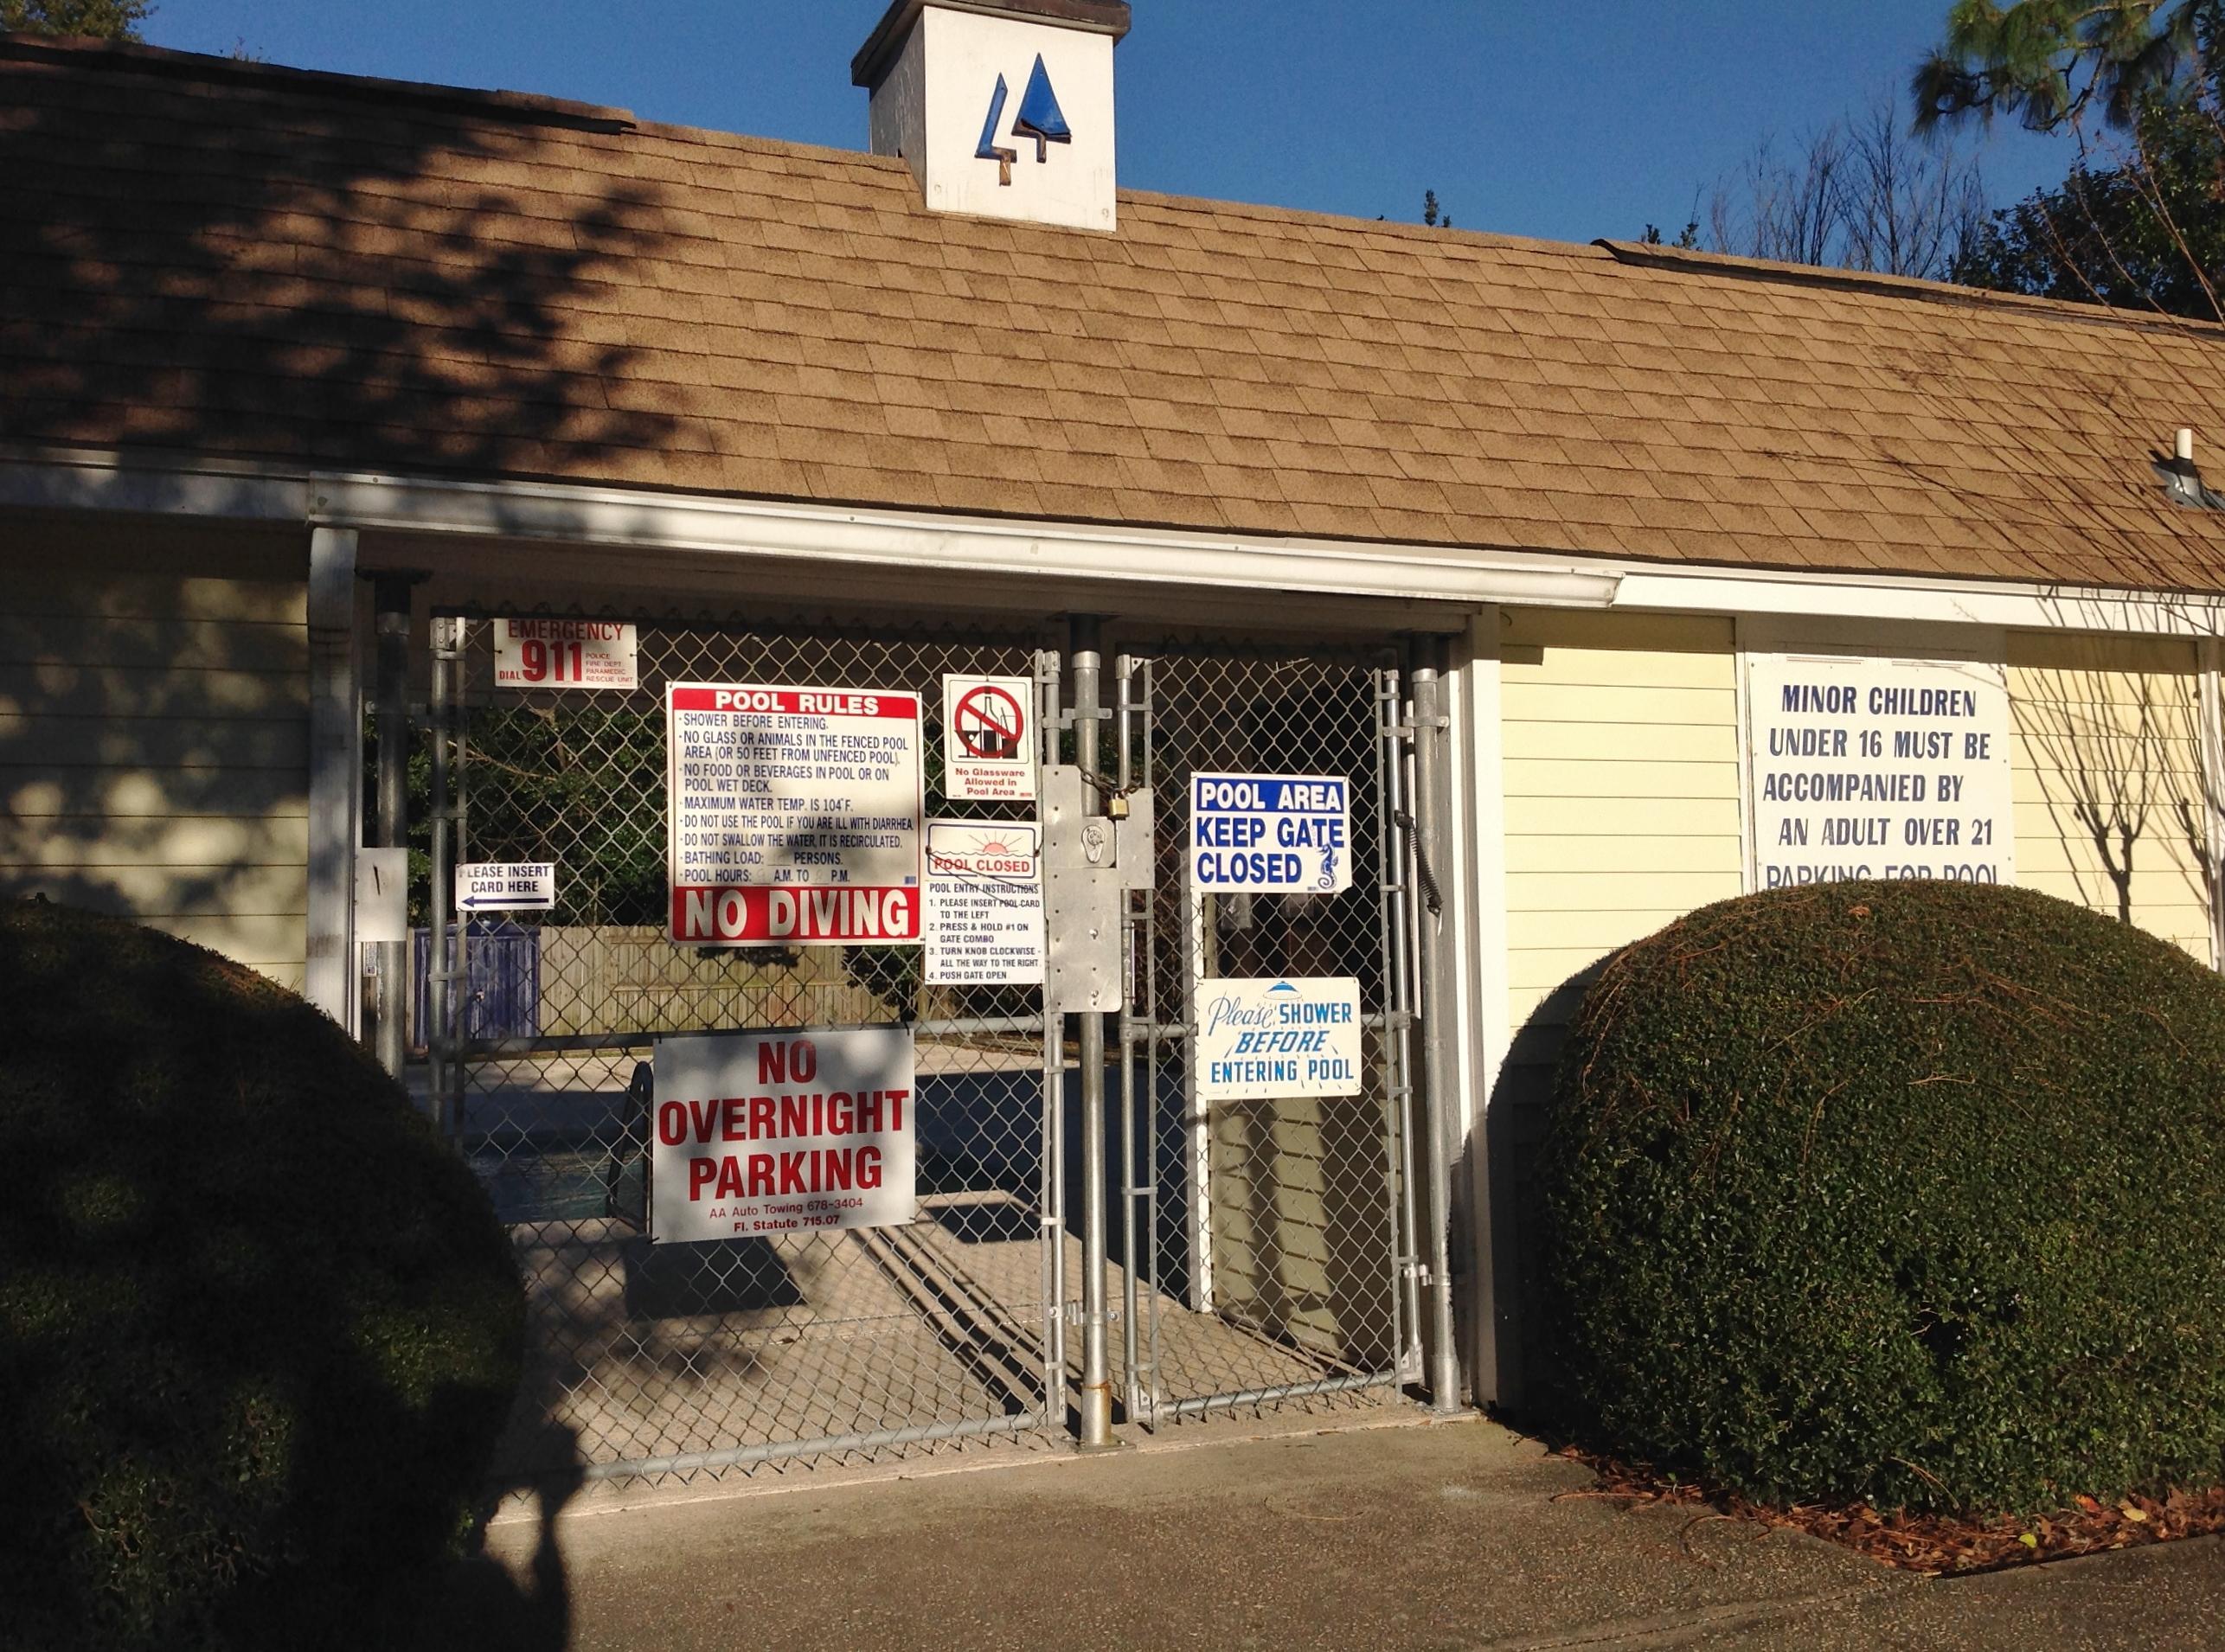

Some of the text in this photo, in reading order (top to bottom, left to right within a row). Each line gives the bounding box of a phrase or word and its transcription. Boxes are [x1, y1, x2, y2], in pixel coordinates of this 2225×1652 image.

[509, 619, 623, 641] EMERGENCY
[500, 639, 581, 682] DIAL 911
[715, 691, 879, 715] POOL RULES
[1782, 685, 1976, 717] MINOR CHILDREN
[684, 713, 727, 726] SHOWER
[734, 714, 773, 728] BEFORE
[684, 731, 908, 750] NO GLASS OR ANIMALS IN THE FENCED POOL
[1770, 728, 1990, 759] UNDER 16 MUST BE
[685, 746, 712, 759] AREA
[715, 746, 733, 761] (OR
[737, 747, 750, 760] 50
[753, 748, 778, 760] FEET
[782, 748, 810, 761] FROM
[814, 749, 866, 762] UNFENCED
[684, 764, 889, 781] NO FOOD OR BEVERAGES IN POOL OR ON
[972, 768, 1026, 777] Glassware
[685, 778, 772, 792] POOL WET DECK.
[1763, 772, 1963, 802] ACCOMPANIED BY
[685, 797, 735, 810] MAXIMUM
[740, 797, 774, 810] WATER
[810, 799, 820, 811] IS
[1201, 782, 1341, 810] POOL AREA
[685, 815, 697, 827] DO
[701, 815, 719, 827] NOT
[722, 815, 738, 828] USE
[742, 816, 757, 828] THE
[761, 816, 783, 829] POOL
[787, 816, 793, 829] IF
[797, 816, 814, 829] YOU
[817, 817, 833, 829] ARE
[836, 817, 847, 830] ILL
[850, 817, 870, 830] WITH
[1196, 817, 1344, 848] KEEP GATE
[1779, 818, 1992, 845] AN ADULT OVER 21
[685, 833, 697, 846] DO
[701, 833, 719, 846] NOT
[723, 834, 765, 847] SWALLOW
[768, 834, 783, 847] THE
[819, 835, 827, 847] IT
[830, 835, 837, 847] IS
[685, 851, 730, 864] BATHING
[734, 852, 764, 864] LOAD:
[934, 859, 1030, 872] POOL CLOSED
[1197, 852, 1302, 884] CLOSED
[508, 866, 549, 877] INSERT
[685, 869, 712, 882] POOL
[715, 870, 752, 882] HOURS:
[797, 870, 809, 882] TO
[471, 881, 539, 893] CARD HERE
[930, 883, 1039, 894] POOL ENTRY INSTRUCTIONS
[685, 889, 908, 938] NO DIVING
[1208, 991, 1352, 1037] Please SHOWER
[1235, 1030, 1330, 1053] BEFORE
[758, 1040, 817, 1085] NO
[1212, 1059, 1354, 1083] ENTERING POOL
[659, 1090, 909, 1146] OVERNIGHT
[689, 1146, 882, 1201] PARKING
[709, 1198, 864, 1219] AA Auto Towing 678-3404
[753, 1218, 798, 1231] Statute
[803, 1215, 840, 1226] 715.07
